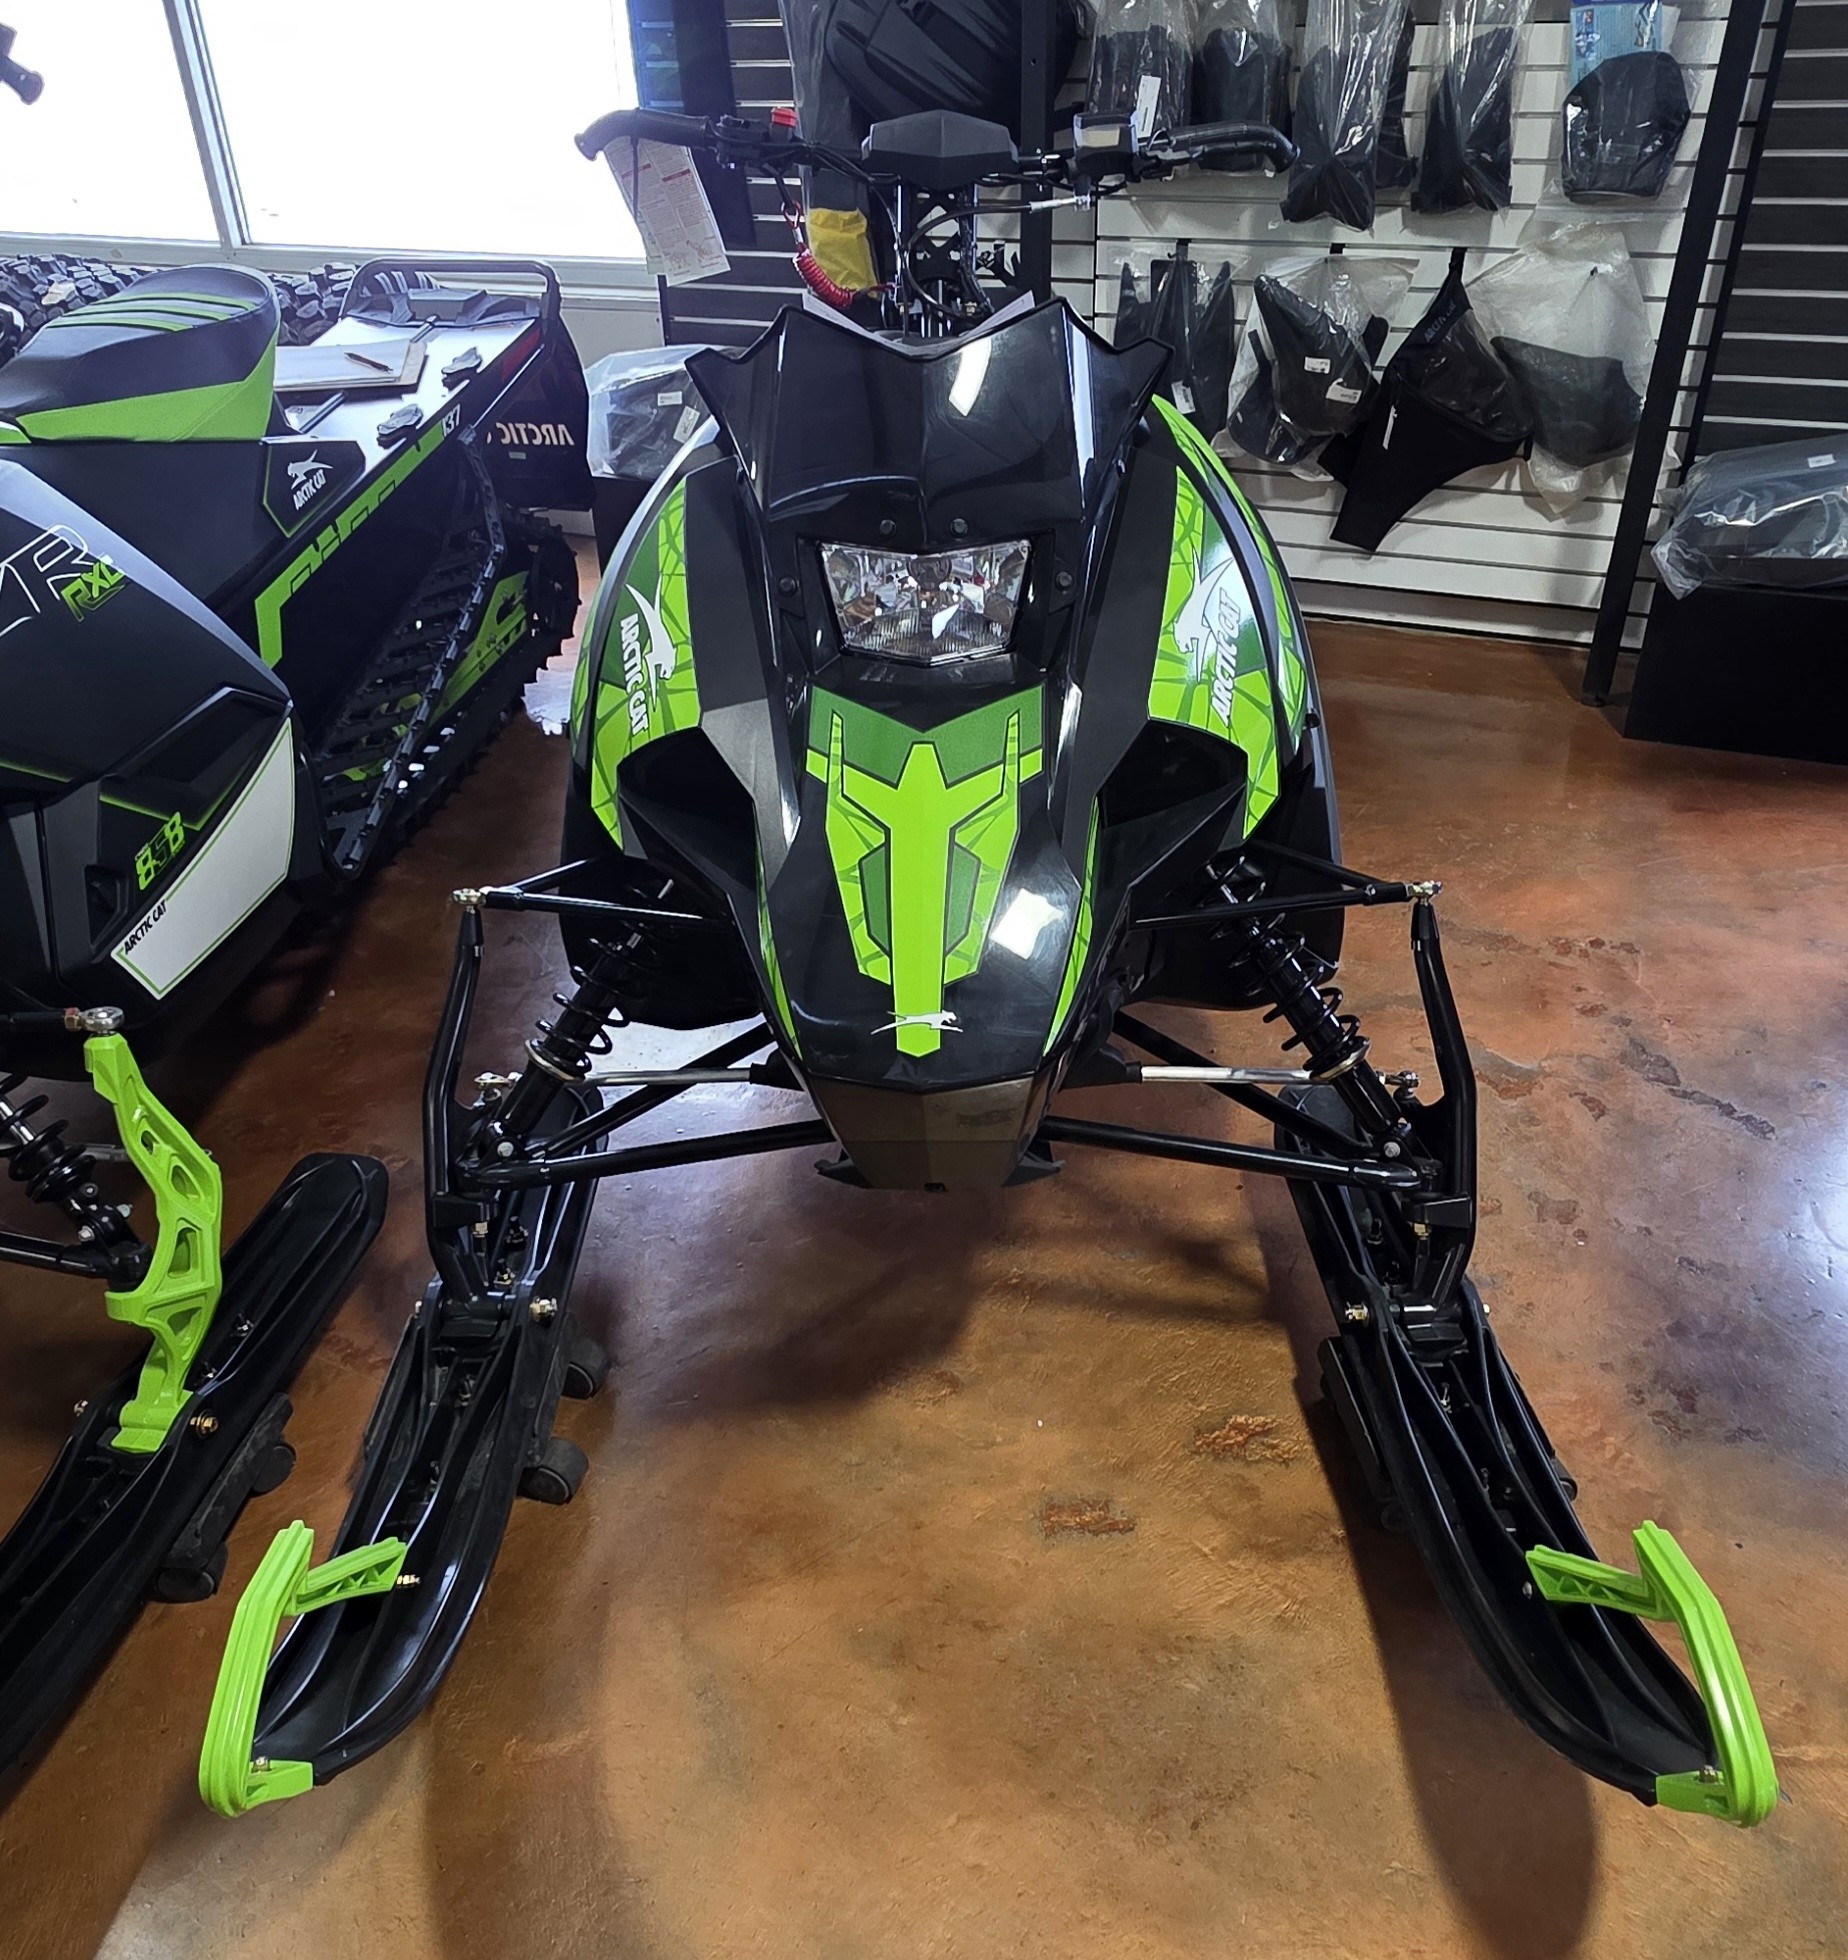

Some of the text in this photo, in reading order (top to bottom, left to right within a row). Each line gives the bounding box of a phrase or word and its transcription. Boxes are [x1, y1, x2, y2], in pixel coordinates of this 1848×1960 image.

[442, 403, 461, 437] 137
[293, 469, 327, 511] ARCTIC CAT
[621, 612, 649, 736] ARCTIC CAT
[1210, 587, 1241, 730] ARCTIC CAT
[136, 811, 185, 891] 858
[123, 900, 167, 956] ARCTIC CAT
